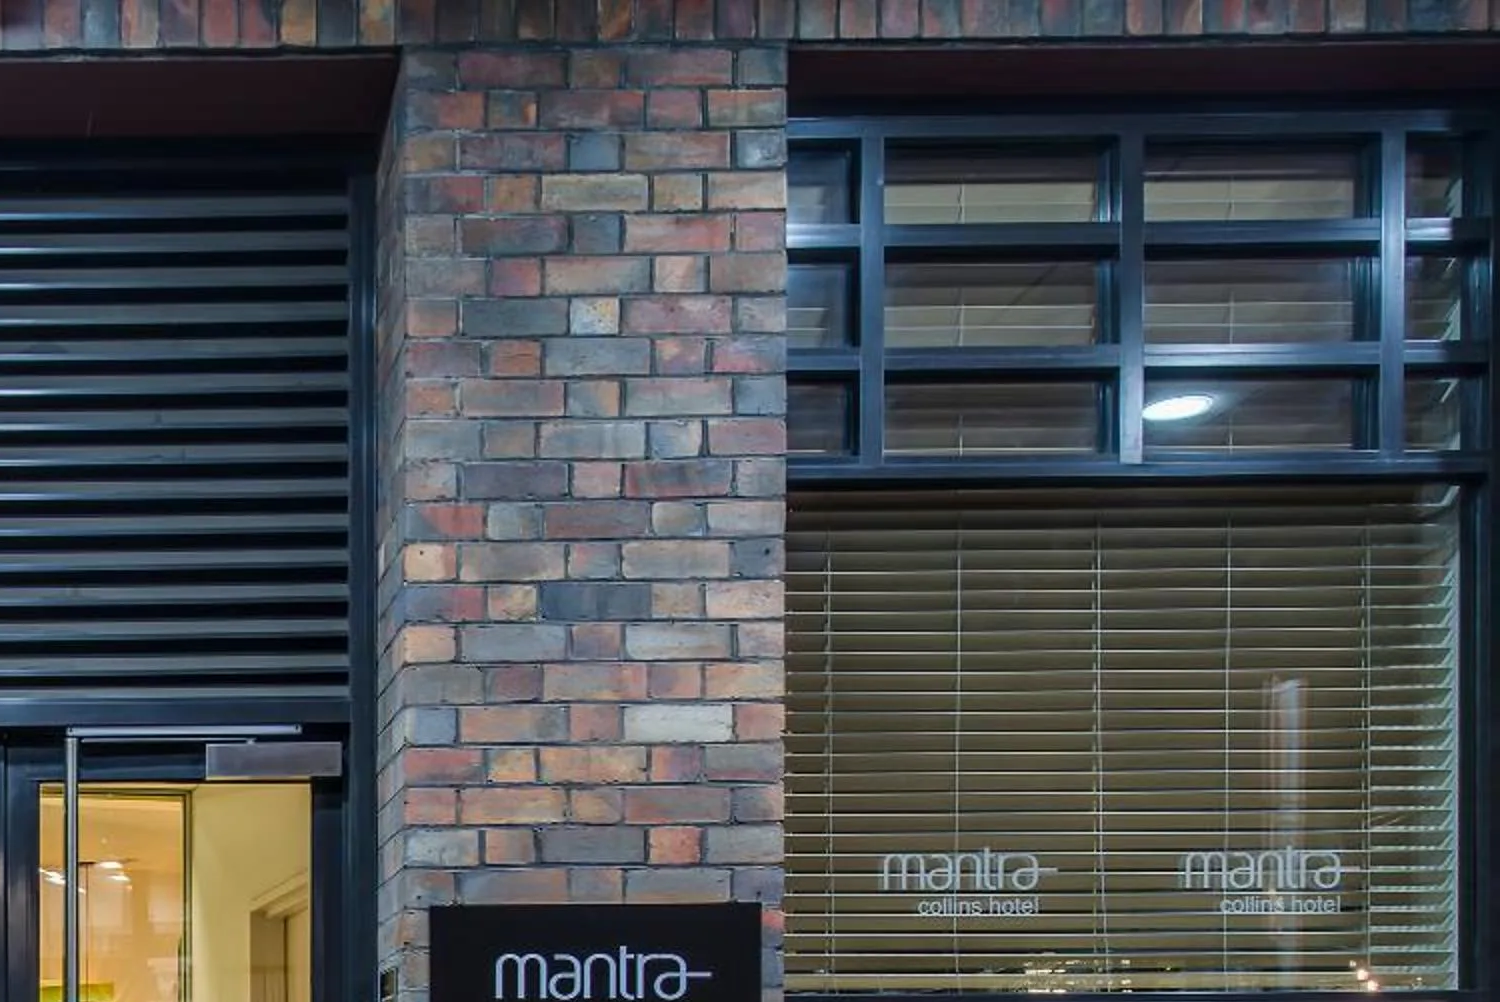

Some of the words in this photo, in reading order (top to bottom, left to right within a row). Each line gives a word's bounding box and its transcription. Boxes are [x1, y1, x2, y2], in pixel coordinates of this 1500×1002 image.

[883, 847, 1058, 890] mantra
[1186, 846, 1362, 889] mantra
[918, 897, 983, 915] collins
[989, 897, 1039, 915] hotel
[1220, 896, 1285, 913] collins
[1292, 896, 1341, 913] hotel
[495, 945, 712, 1000] mantra
